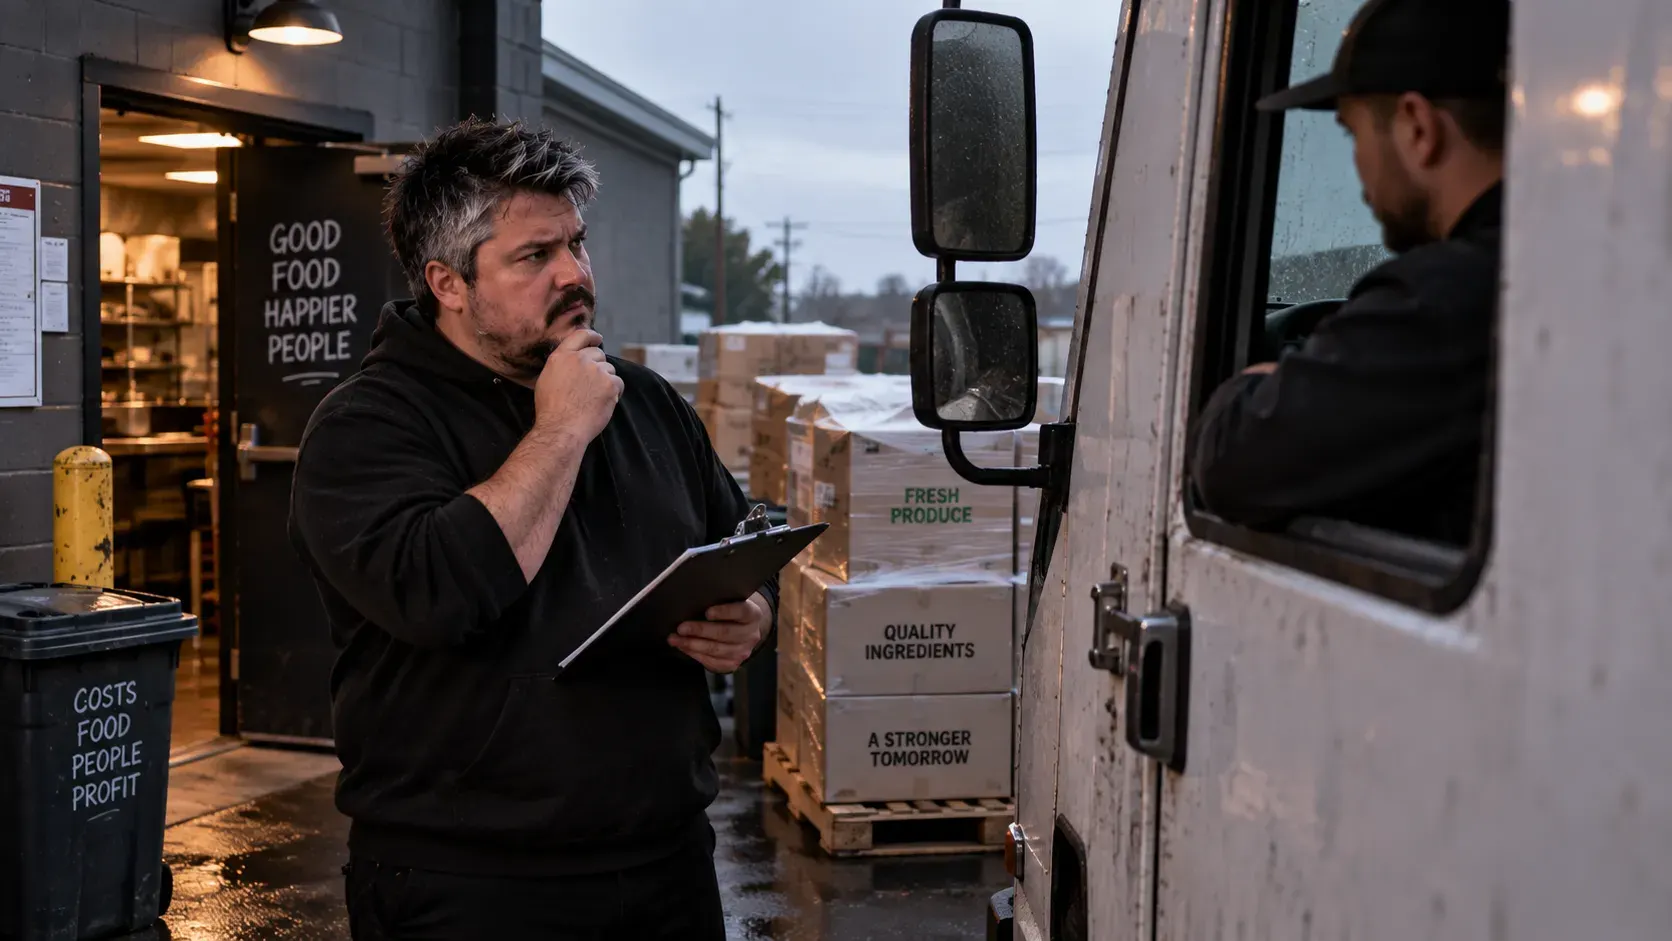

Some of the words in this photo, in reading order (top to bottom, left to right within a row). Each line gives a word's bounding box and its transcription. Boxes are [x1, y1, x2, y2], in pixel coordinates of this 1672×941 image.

[269, 219, 342, 255] GOOD
[272, 257, 341, 292] FOOD
[264, 294, 358, 328] HAPPIER
[268, 330, 351, 365] PEOPLE
[904, 487, 960, 504] FRESH
[890, 506, 972, 524] PRODUCE
[884, 623, 956, 641] QUALITY
[865, 642, 975, 660] INGREDIENTS
[73, 680, 138, 714] COSTS
[77, 712, 131, 747] FOOD
[868, 732, 880, 748] A
[884, 730, 972, 747] STRONGER
[72, 740, 143, 780] PEOPLE
[870, 749, 970, 767] TOMORROW
[72, 771, 142, 811] PROFIT
